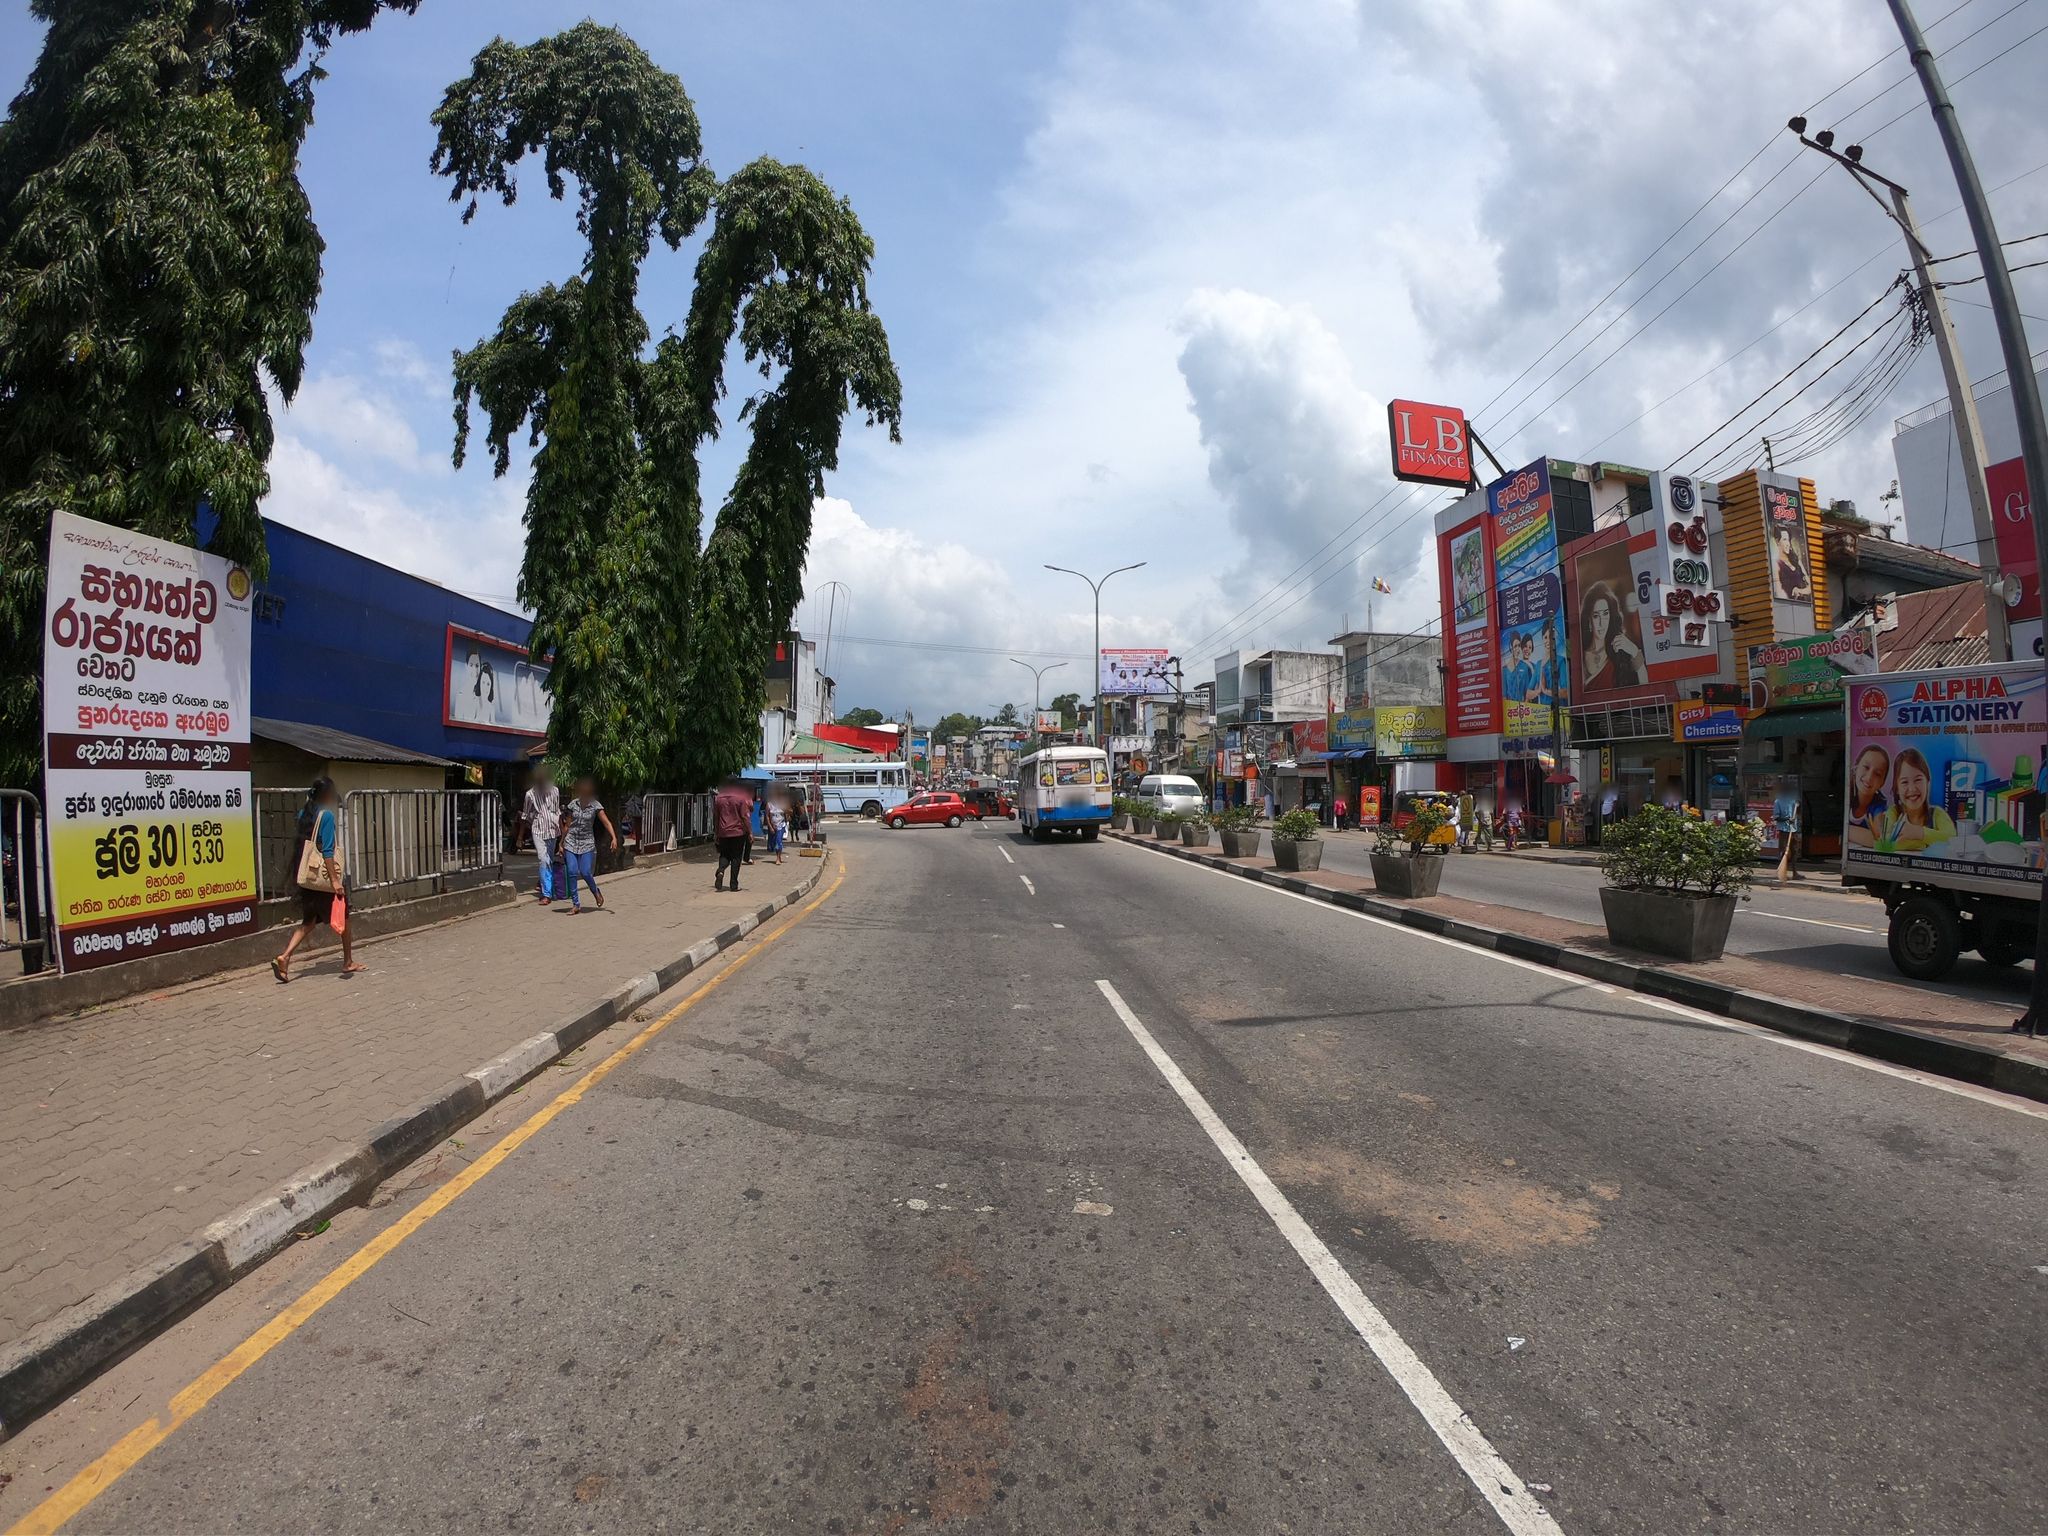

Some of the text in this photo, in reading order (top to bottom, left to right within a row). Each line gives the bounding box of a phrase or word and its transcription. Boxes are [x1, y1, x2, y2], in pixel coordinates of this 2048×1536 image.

[1401, 449, 1465, 469] FINANCE
[80, 564, 217, 624] සභ්‍යත්ව
[52, 598, 202, 665] රාජ්‍යයක්
[1685, 622, 1706, 642] 27
[77, 653, 136, 682] වෙතට
[78, 685, 229, 710] ස්වදේශික දැනුම රැගෙන යන
[1912, 675, 2008, 703] ALPHA
[1679, 707, 1705, 721] City
[1864, 706, 1882, 714] ALPHA
[1898, 701, 2023, 724] STATIONERY
[1685, 724, 1738, 736] Chemists
[76, 738, 124, 765] දෙවැනි
[128, 739, 168, 761] ජාතික
[171, 745, 190, 761] මහ
[65, 792, 96, 820] පූජ්‍ය
[225, 787, 242, 808] හිමි
[192, 820, 223, 837] සවස
[95, 824, 178, 879] ජූලි 30
[192, 838, 224, 865] 3.30
[145, 872, 185, 889] මහරගම
[70, 899, 102, 915] ජාතික
[108, 894, 141, 909] තරුණ
[146, 888, 170, 904] සේවා
[175, 888, 193, 899] සභා
[73, 933, 122, 955] ධර්මපාල
[126, 923, 159, 946] පරපුර
[227, 907, 252, 925] සභාව
